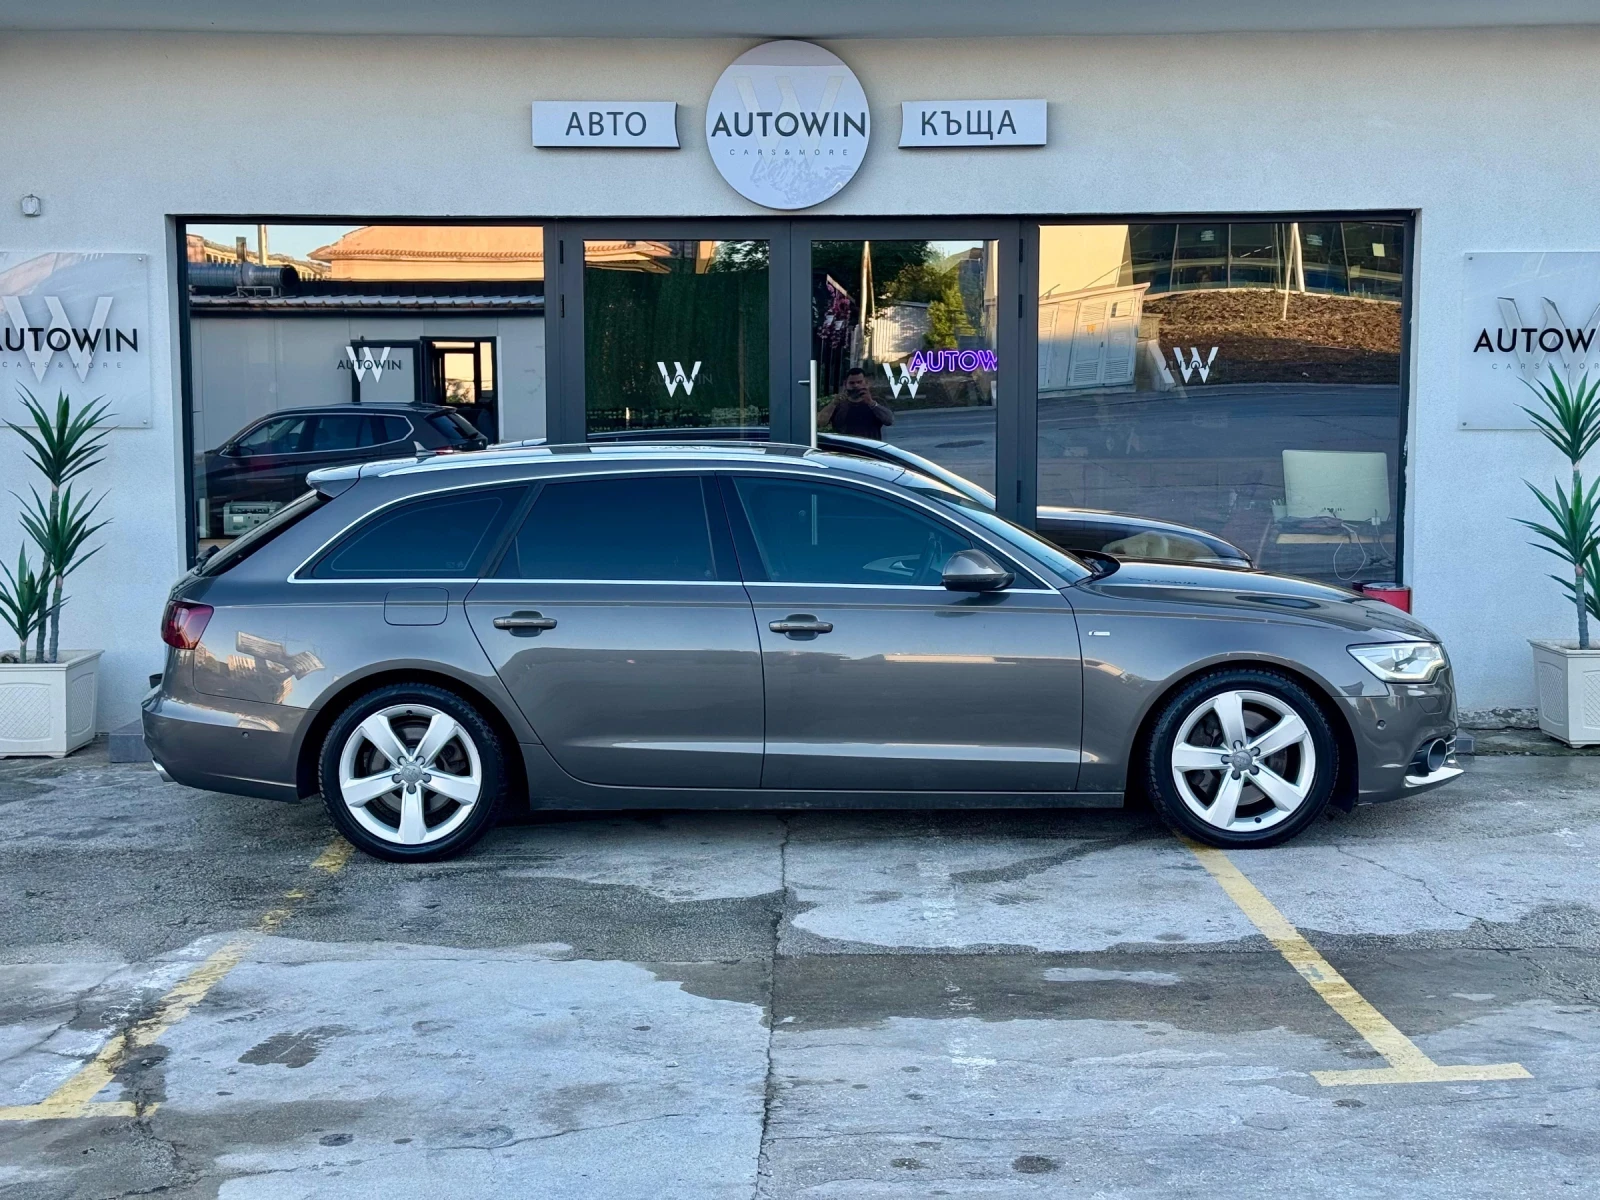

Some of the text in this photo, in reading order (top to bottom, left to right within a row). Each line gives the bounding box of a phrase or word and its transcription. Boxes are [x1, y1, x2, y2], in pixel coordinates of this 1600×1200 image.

[565, 111, 647, 137] АВТО
[711, 111, 866, 138] AUTOWIN
[921, 109, 1017, 140] КЪЩА
[0, 327, 139, 353] UTOWIN
[1473, 327, 1600, 353] AUTOW
[337, 359, 402, 371] AUTOWIN
[1172, 346, 1219, 384] W
[1491, 362, 1600, 370] CARSMOR
[656, 360, 702, 398] W
[882, 362, 927, 399] W
